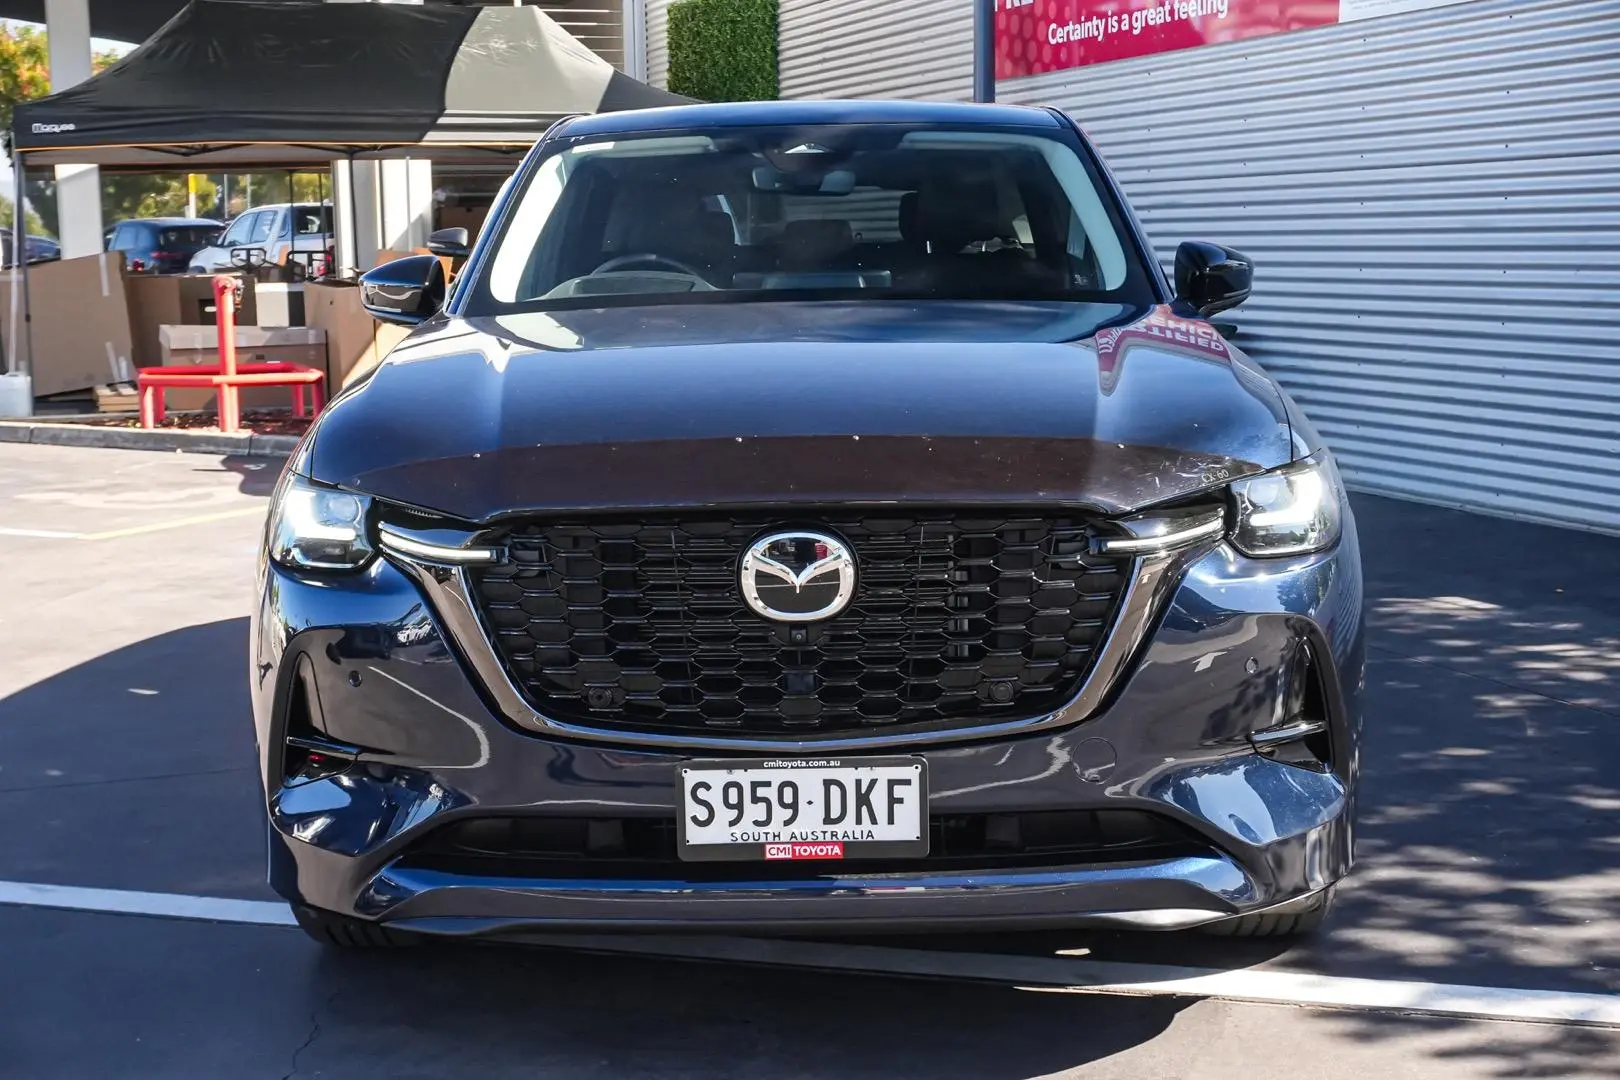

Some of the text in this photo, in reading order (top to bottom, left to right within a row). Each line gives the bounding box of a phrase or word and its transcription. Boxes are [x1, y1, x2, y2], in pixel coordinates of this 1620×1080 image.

[1048, 0, 1229, 45] Certainty is a great feeling
[1201, 469, 1229, 483] CX-60
[763, 759, 841, 769] cmitoyota.com.au
[730, 830, 875, 842] SOUTH AUSTRALIA
[768, 845, 842, 857] CMI TOYOTA
